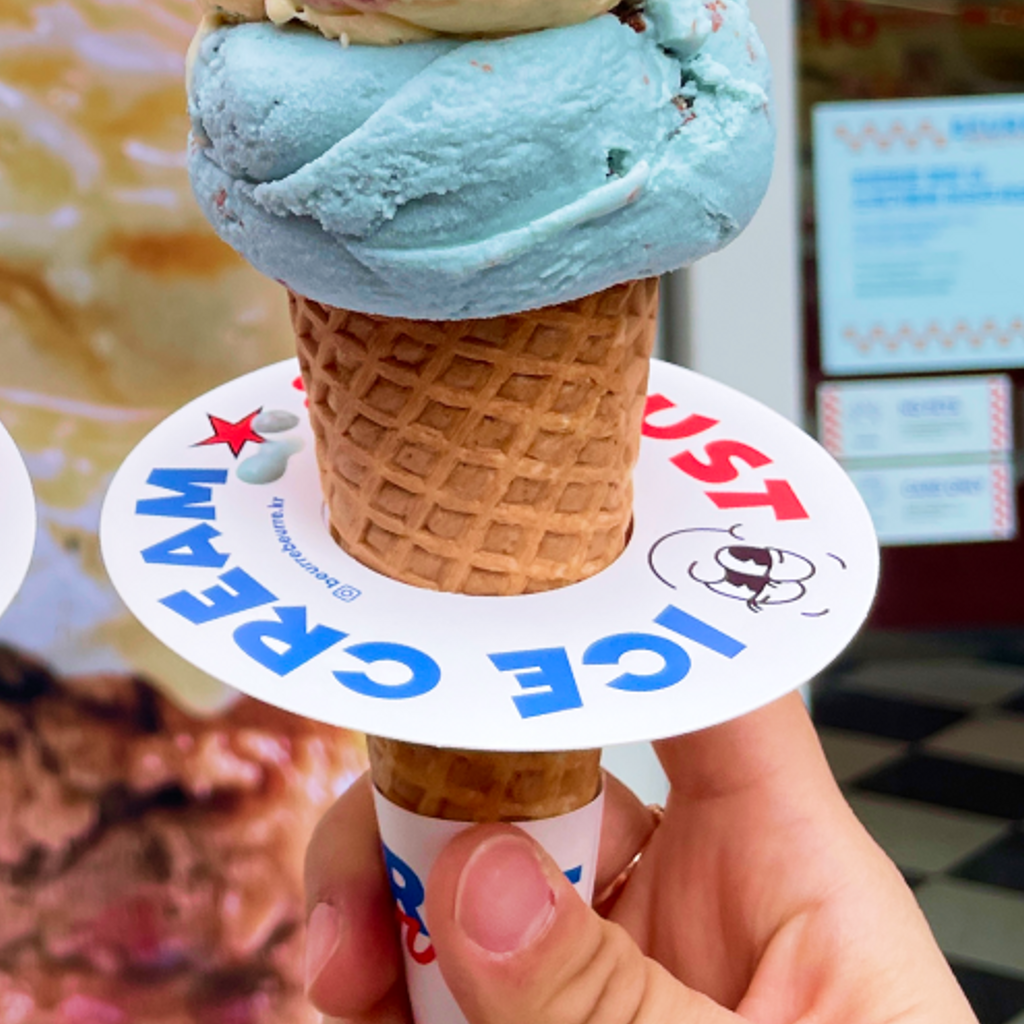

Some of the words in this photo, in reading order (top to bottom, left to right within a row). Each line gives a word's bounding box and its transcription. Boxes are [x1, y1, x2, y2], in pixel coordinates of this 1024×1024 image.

[639, 392, 810, 521] UST
[134, 466, 442, 701] CREAM
[486, 603, 748, 720] ICE
